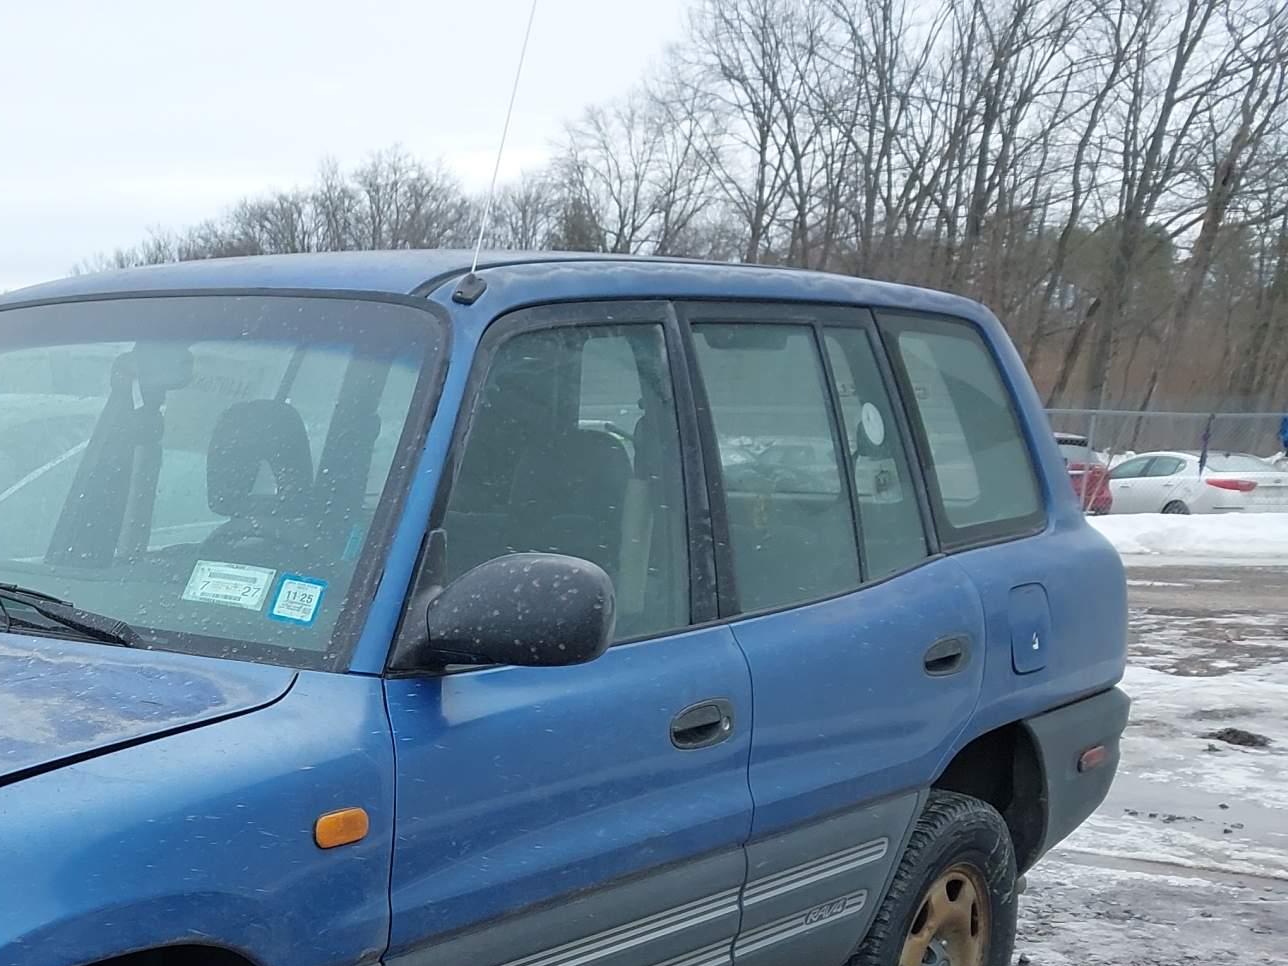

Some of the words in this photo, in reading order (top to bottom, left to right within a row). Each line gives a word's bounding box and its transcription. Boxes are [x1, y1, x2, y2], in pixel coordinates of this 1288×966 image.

[200, 581, 210, 591] 7
[241, 586, 261, 598] 27
[807, 898, 846, 925] RAV4
